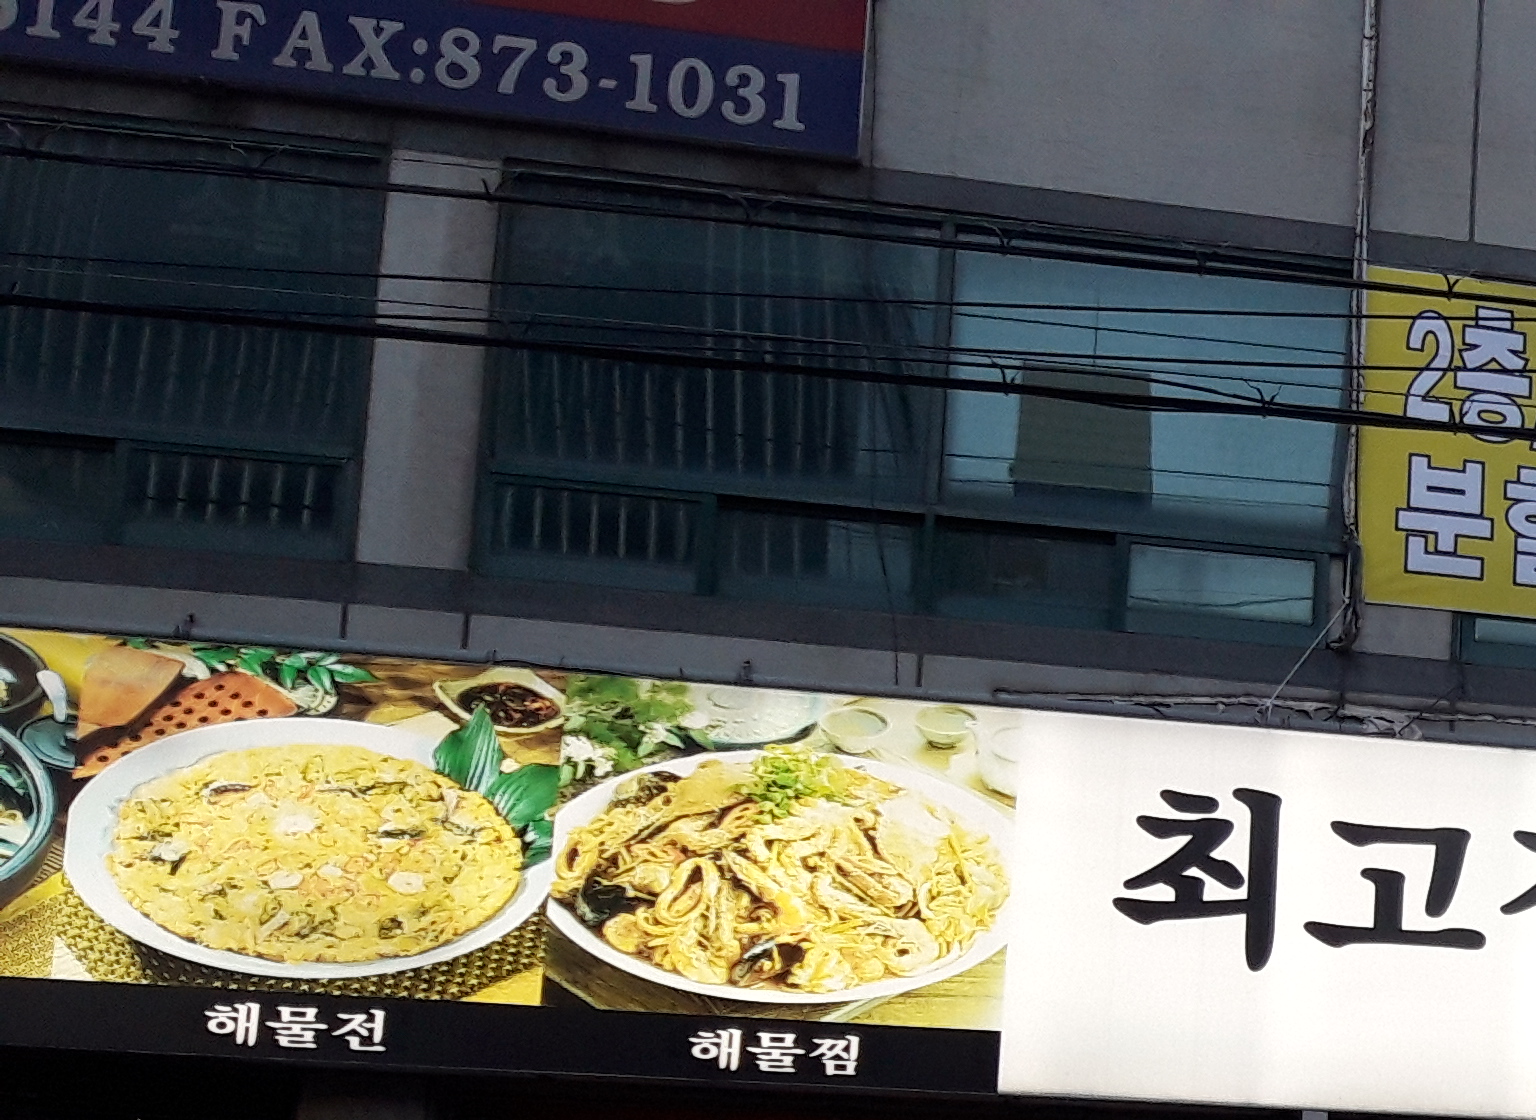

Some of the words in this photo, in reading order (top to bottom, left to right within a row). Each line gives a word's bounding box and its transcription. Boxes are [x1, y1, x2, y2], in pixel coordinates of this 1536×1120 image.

[0, 0, 181, 54] 144
[210, 0, 806, 133] FAX:873-1031
[204, 1000, 388, 1053] 해물전
[689, 1027, 863, 1077] 해물찜
